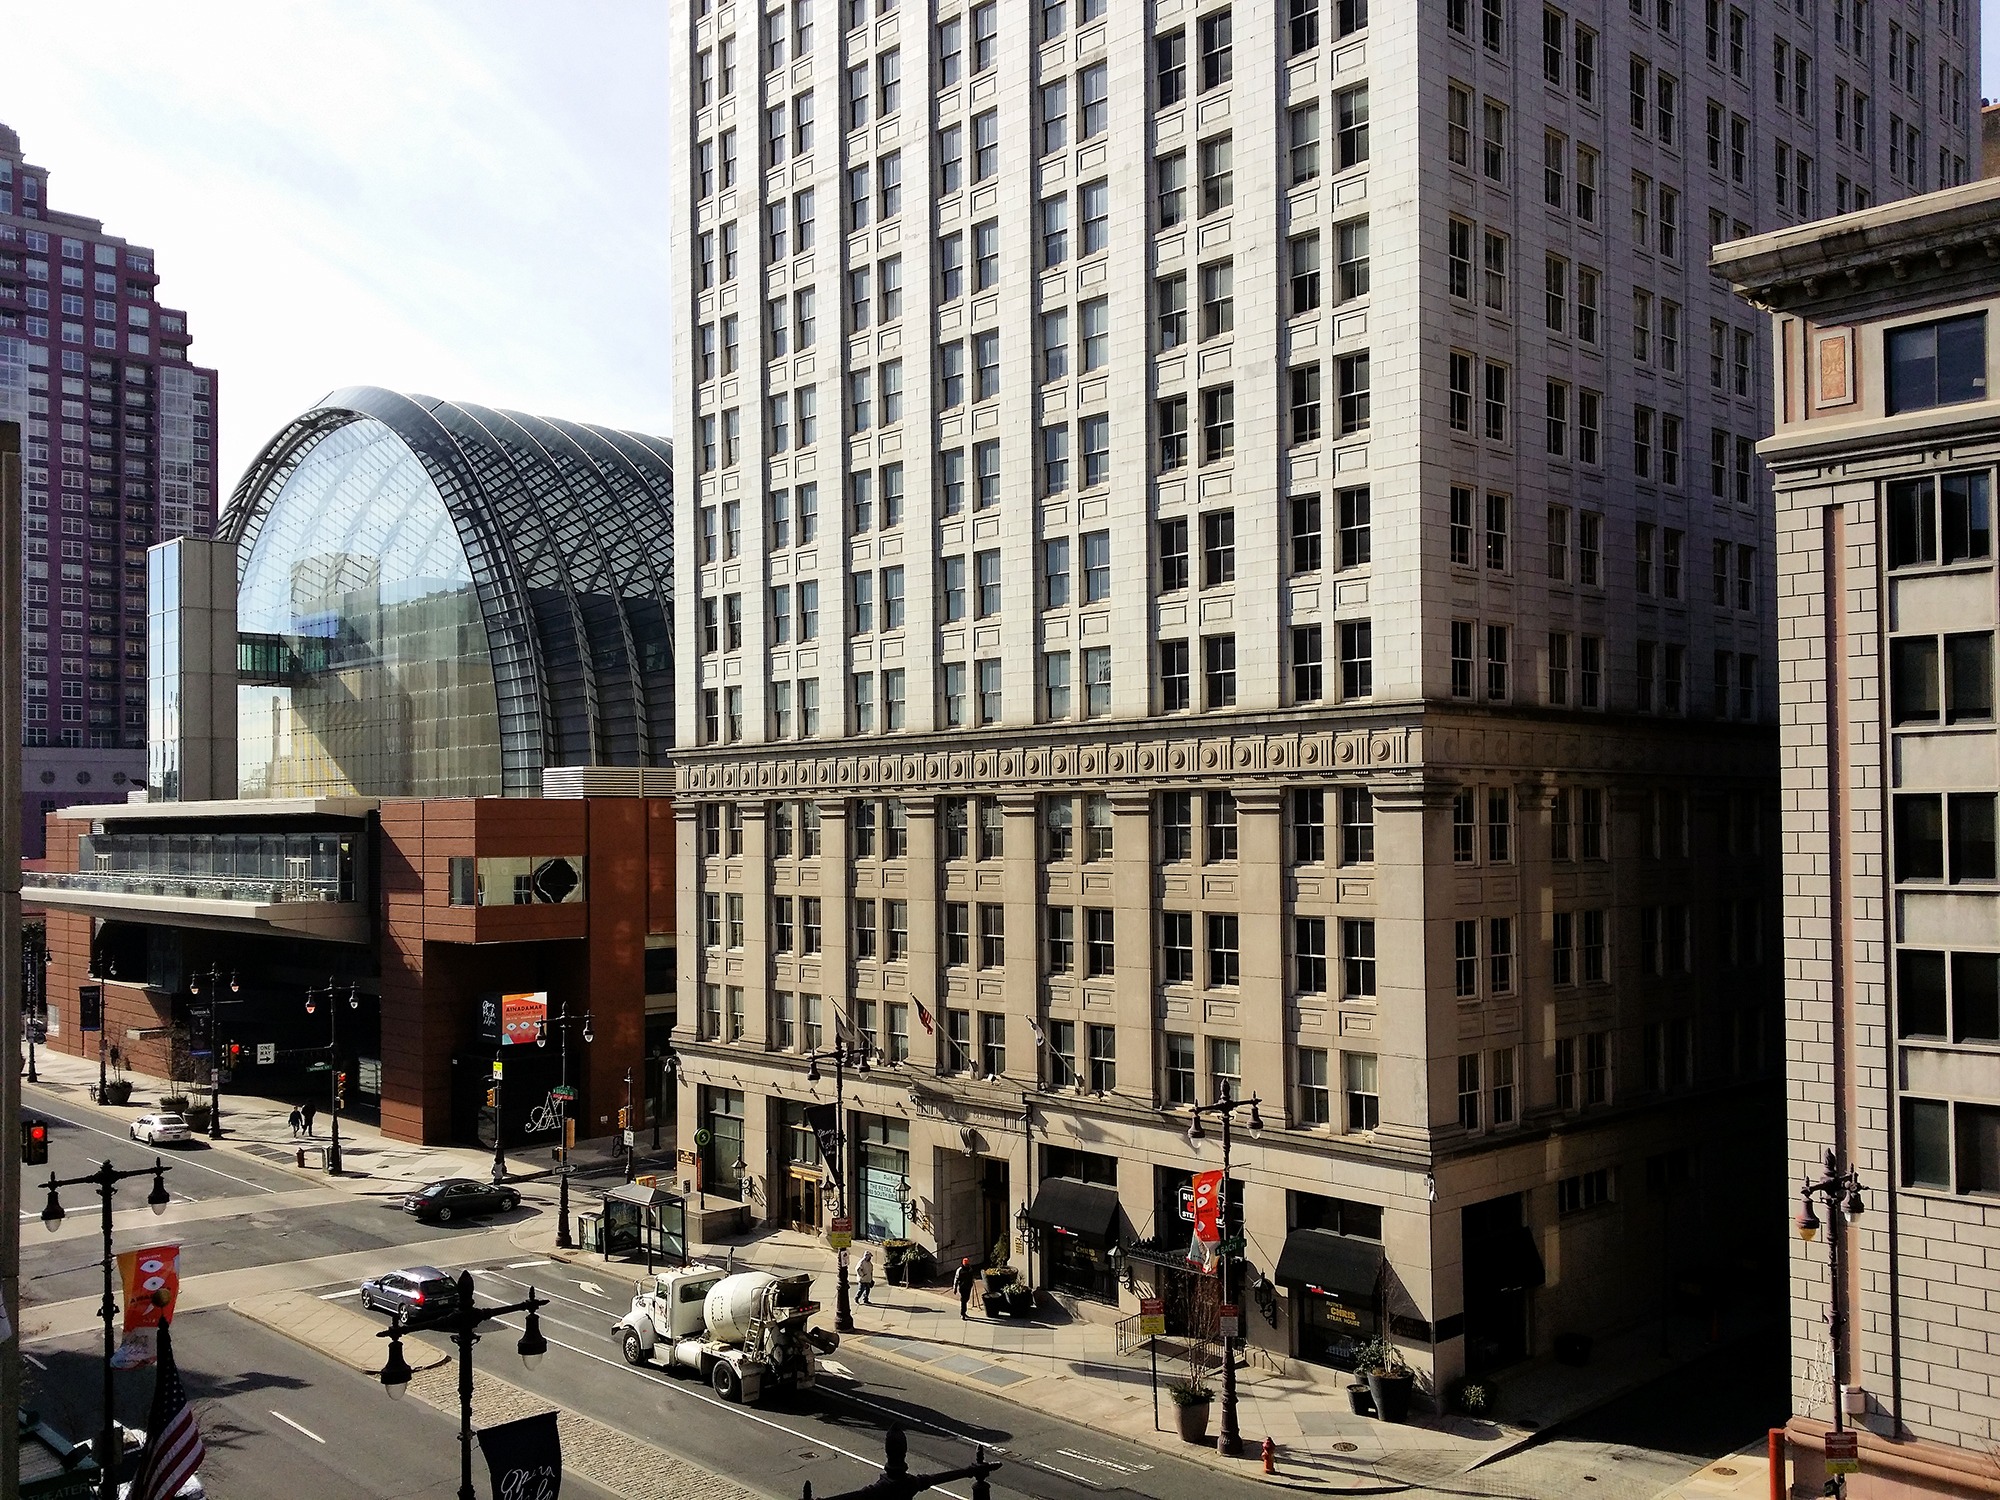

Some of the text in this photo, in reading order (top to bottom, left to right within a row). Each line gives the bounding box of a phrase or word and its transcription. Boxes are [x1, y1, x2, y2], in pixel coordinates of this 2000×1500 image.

[506, 1004, 542, 1012] AINADAMAR
[1220, 1242, 1237, 1254] BACH
[1330, 1307, 1356, 1320] CHRIS
[1344, 1318, 1360, 1326] HOUSE
[501, 1466, 555, 1493] Opera
